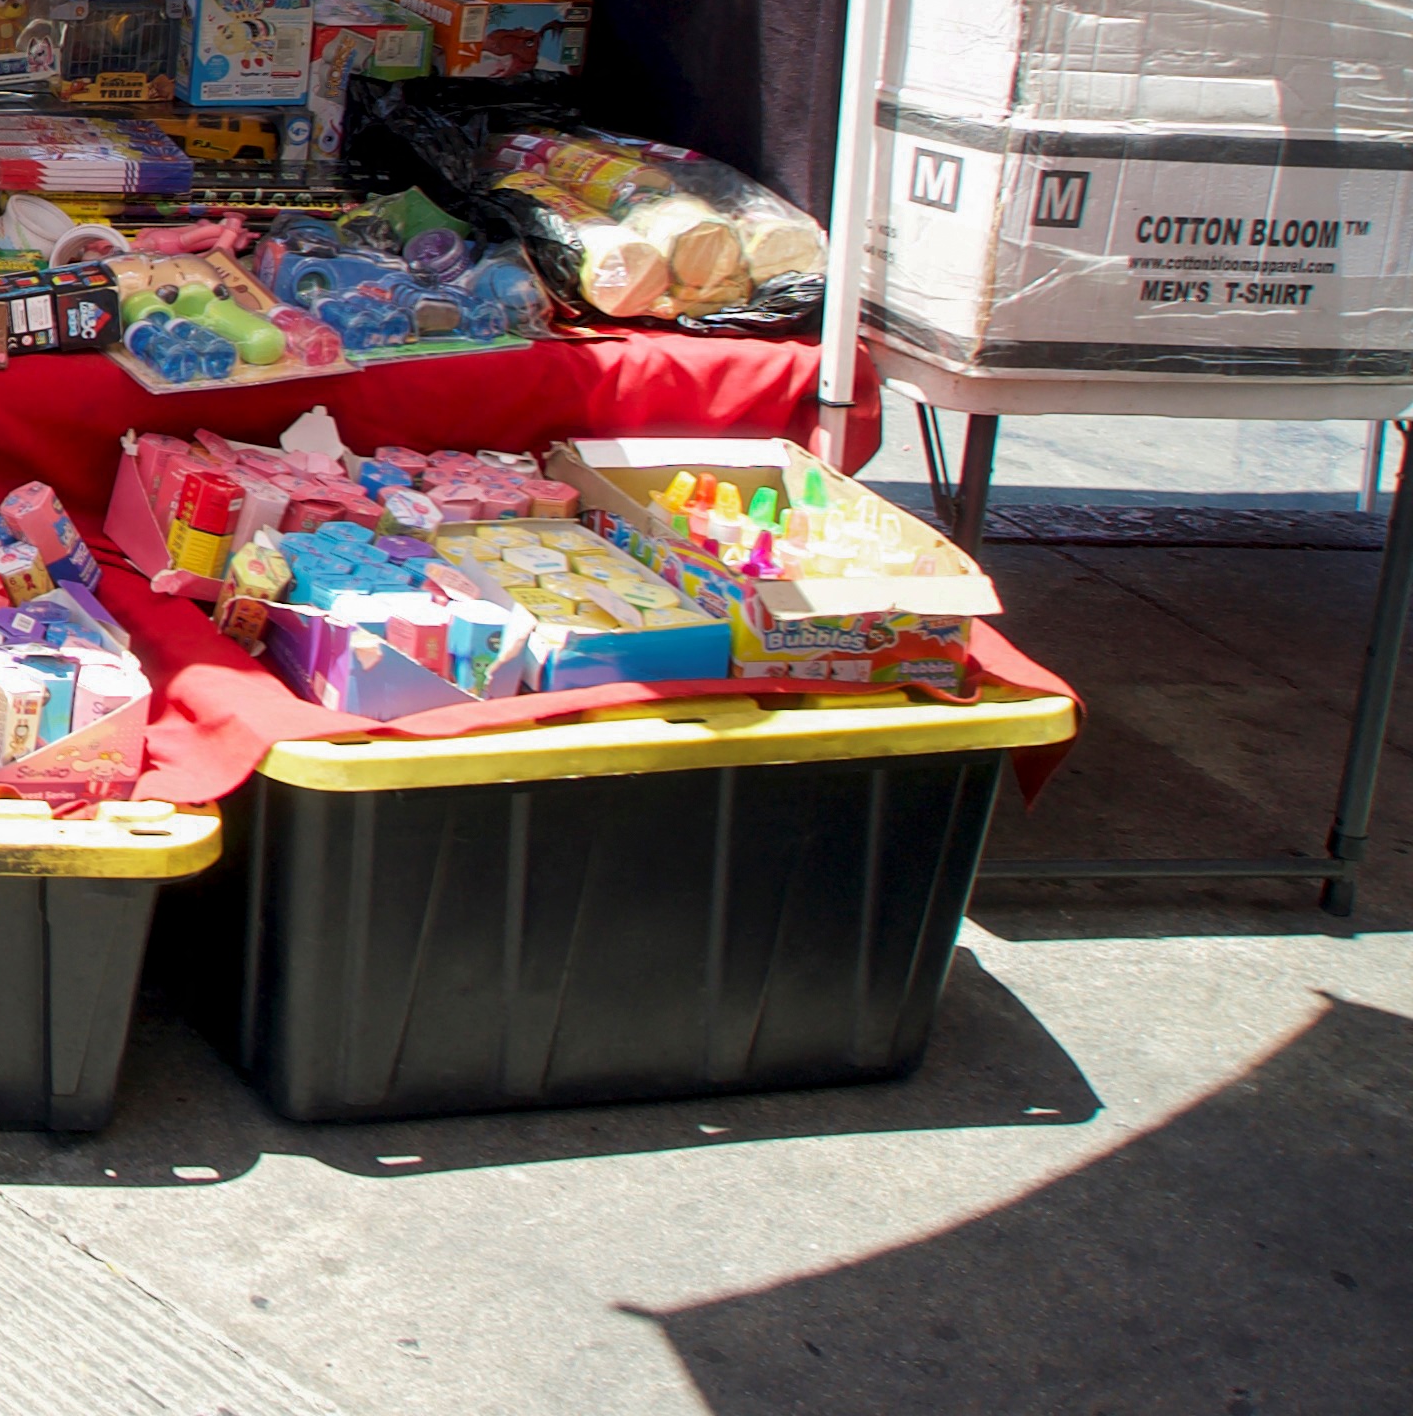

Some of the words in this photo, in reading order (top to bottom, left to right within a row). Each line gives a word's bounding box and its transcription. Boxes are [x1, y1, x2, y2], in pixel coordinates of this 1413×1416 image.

[100, 89, 142, 99] TRIBE
[916, 160, 959, 205] M
[1039, 178, 1081, 223] M
[1136, 215, 1242, 246] COTTON
[1248, 218, 1340, 249] BLOOM
[1128, 256, 1335, 275] www.cottonbloomapparel.com
[1140, 280, 1209, 303] MEN'S
[1225, 282, 1314, 306] T-SHIRT
[765, 631, 868, 652] Bubbles
